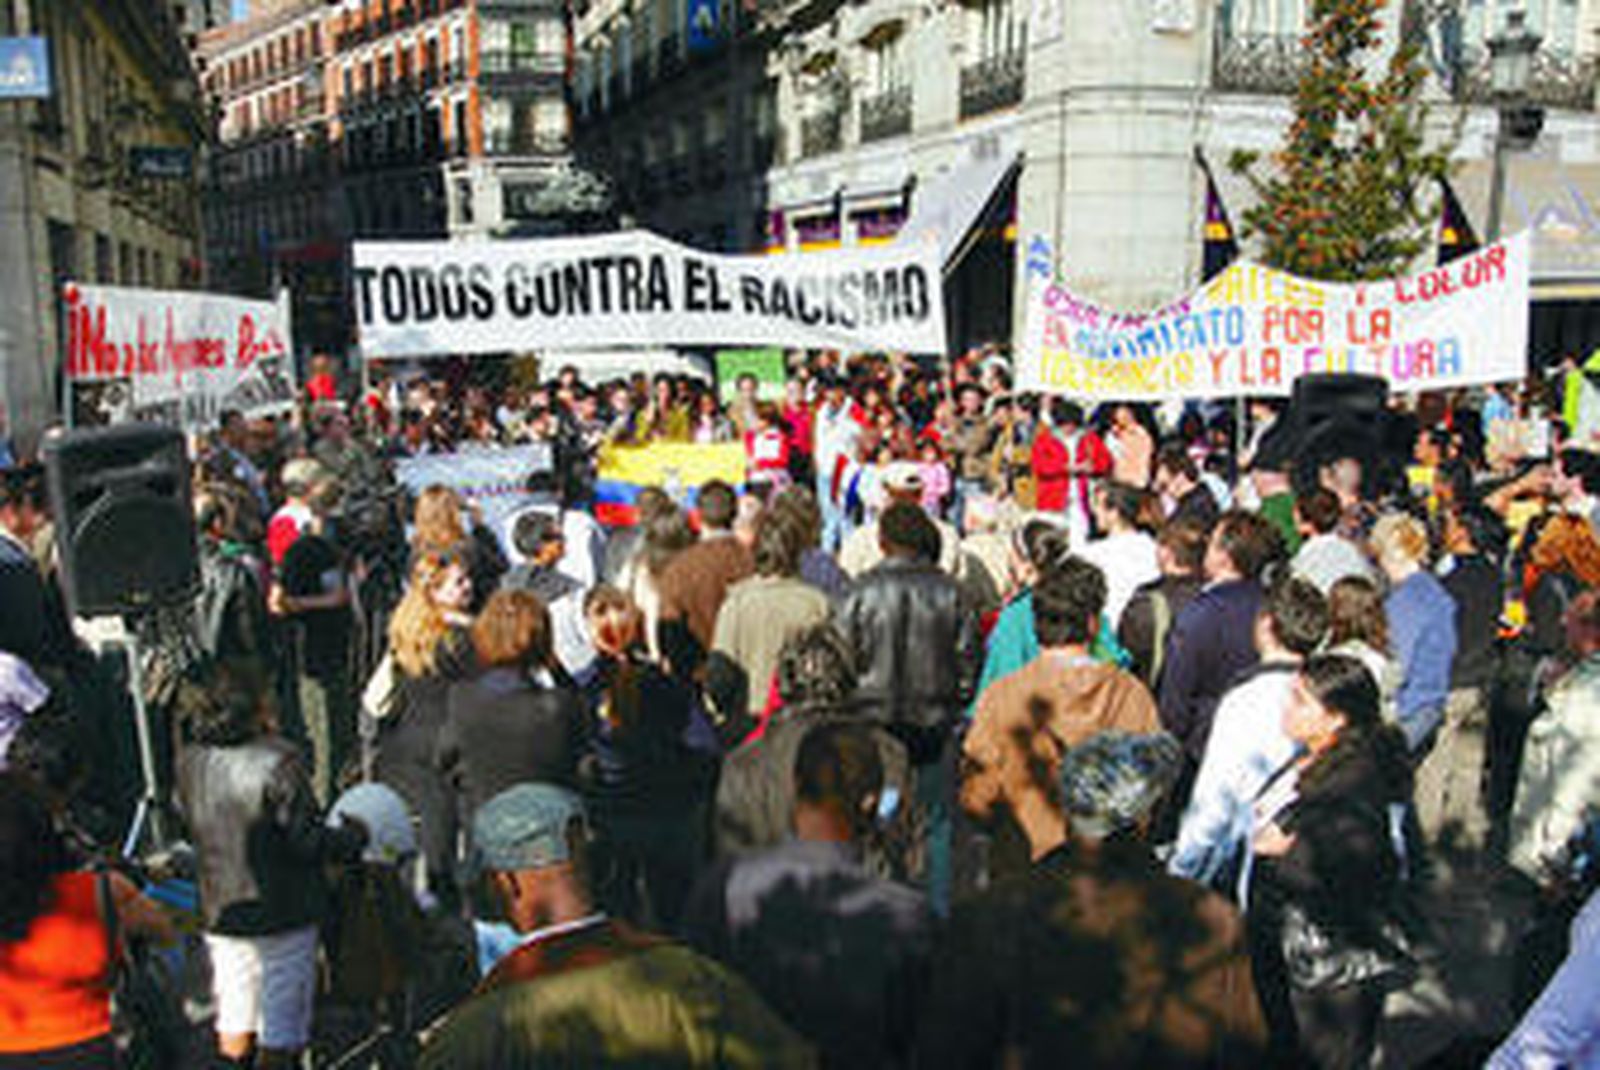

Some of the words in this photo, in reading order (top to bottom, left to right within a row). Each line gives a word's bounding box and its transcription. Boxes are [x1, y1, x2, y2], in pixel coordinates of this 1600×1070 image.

[354, 262, 495, 324] TODOS
[505, 255, 672, 319] CONTRA
[683, 258, 731, 312] EL
[742, 264, 928, 328] RACISMO
[1262, 306, 1325, 343] POR
[1347, 308, 1391, 344] LA
[1209, 347, 1227, 384] Y
[1239, 346, 1281, 385] LA
